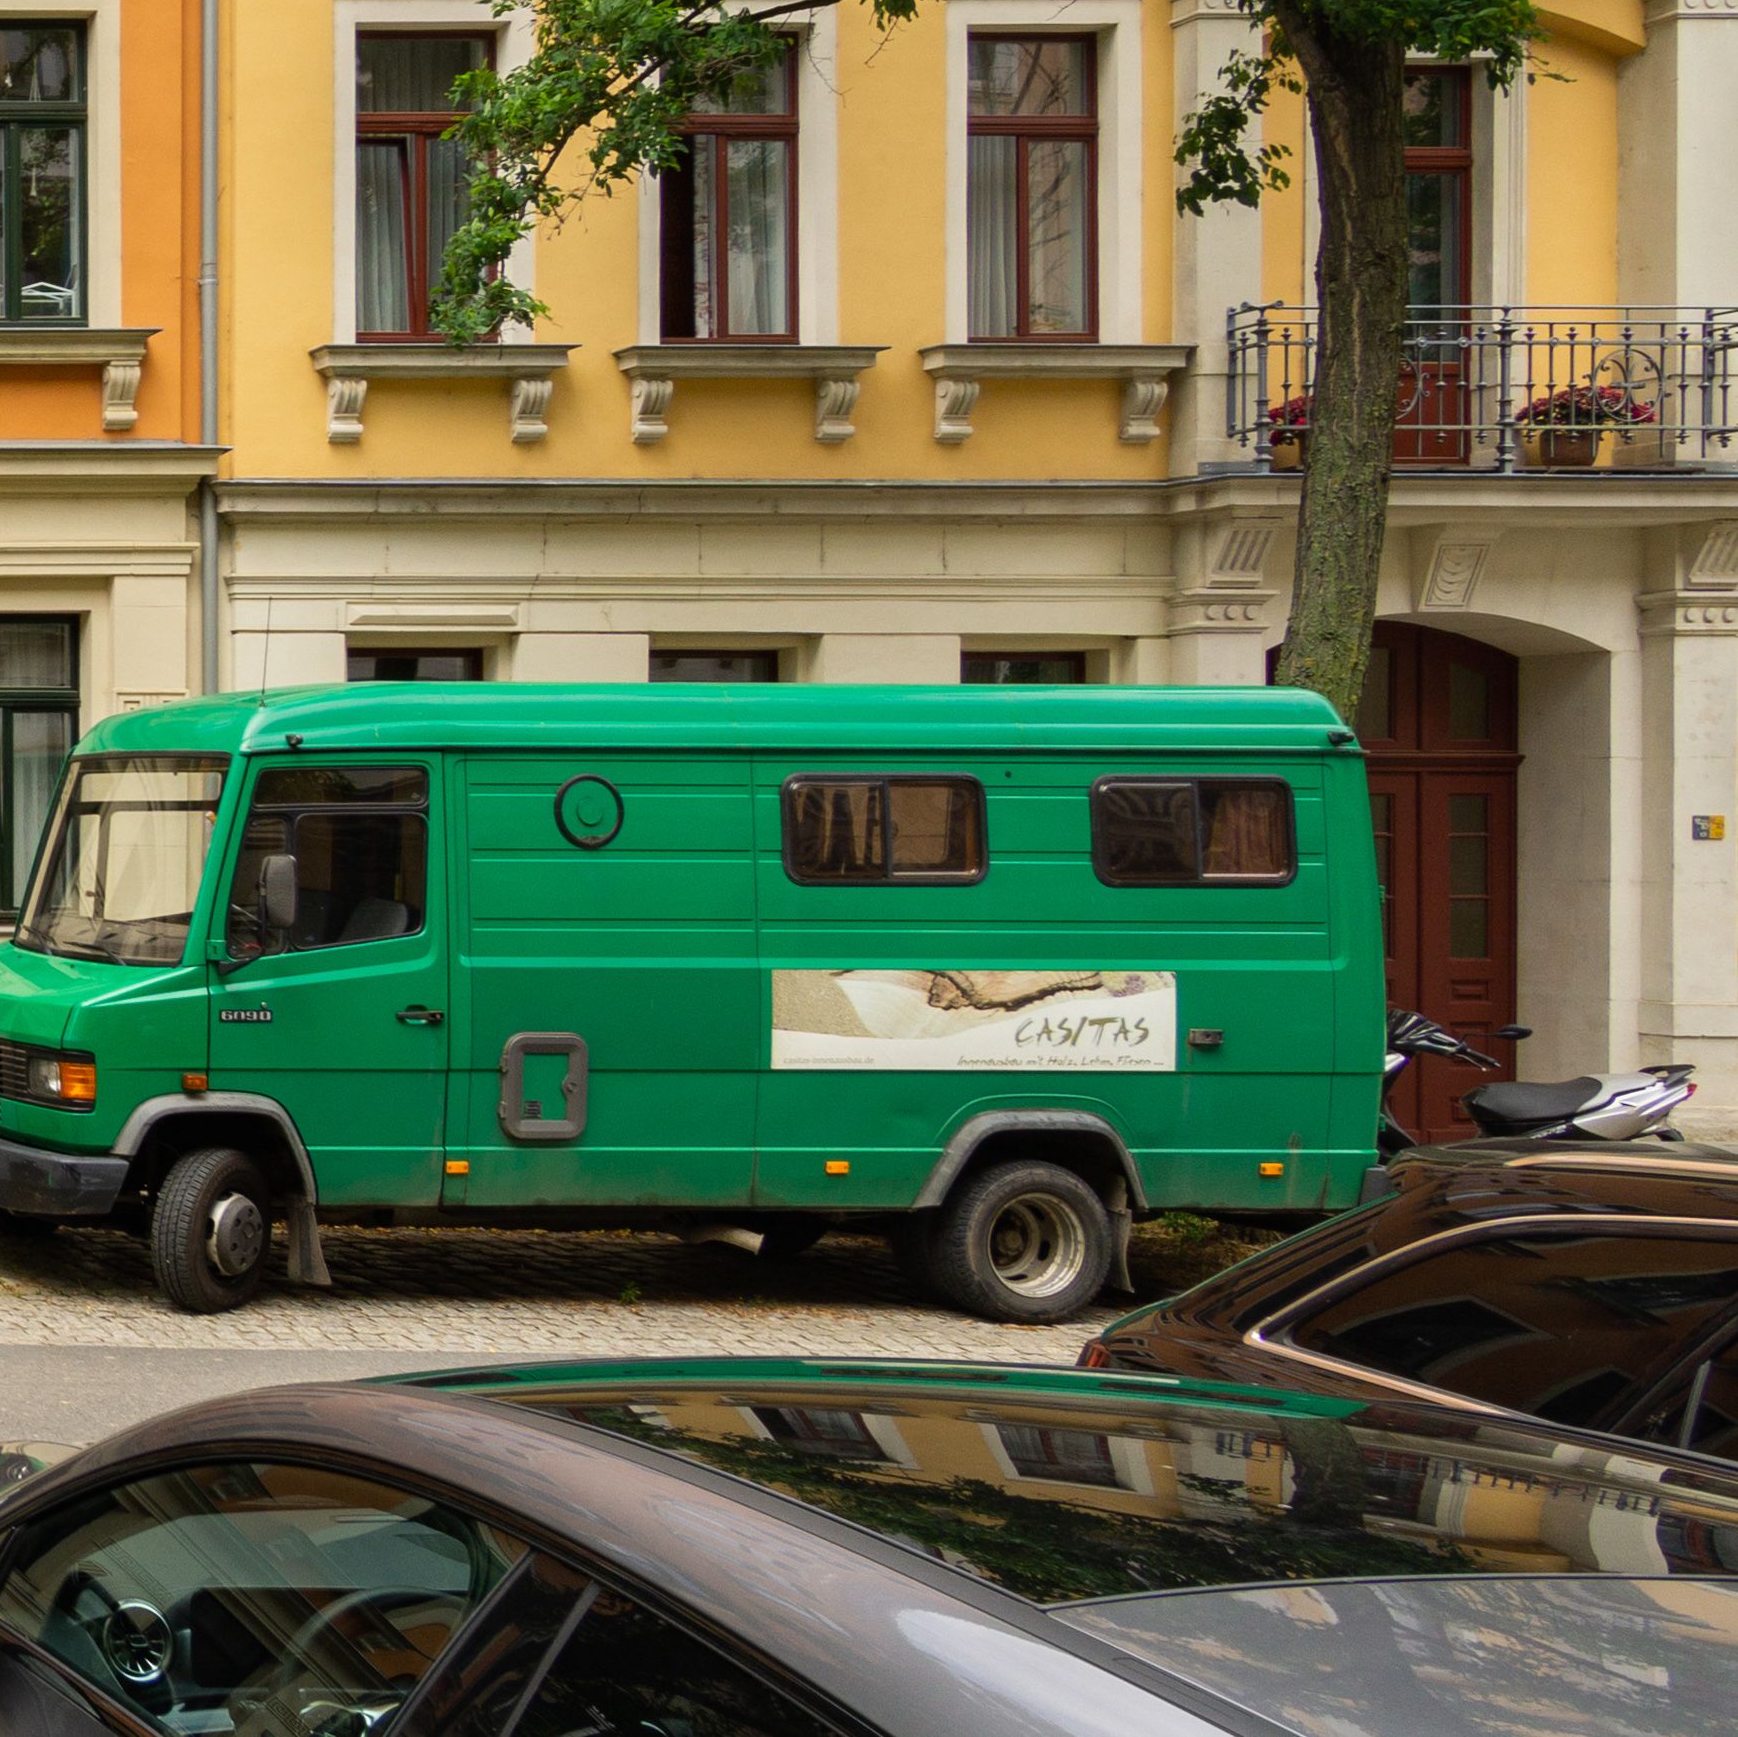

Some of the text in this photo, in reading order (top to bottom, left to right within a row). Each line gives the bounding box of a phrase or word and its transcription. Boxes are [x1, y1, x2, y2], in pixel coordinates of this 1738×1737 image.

[1015, 1016, 1149, 1047] CASITAS
[957, 1055, 1023, 1066] Innenausbau
[1025, 1055, 1043, 1066] mit
